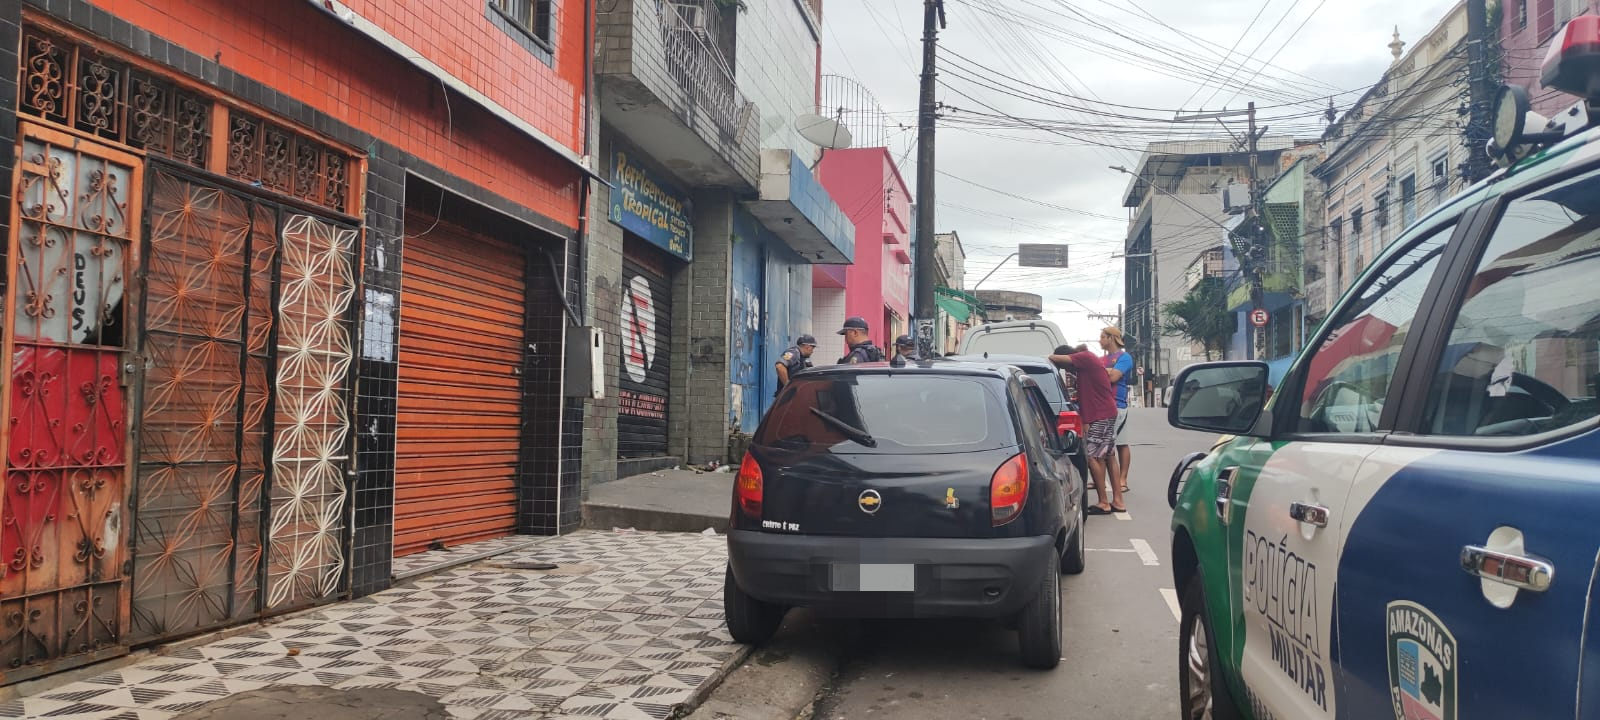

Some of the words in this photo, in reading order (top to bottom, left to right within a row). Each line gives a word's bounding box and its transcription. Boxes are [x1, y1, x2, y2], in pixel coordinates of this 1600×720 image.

[72, 253, 86, 330] DEUS
[1245, 530, 1321, 659] POLÍCIA
[1269, 623, 1328, 713] MILITAR
[1389, 608, 1452, 671] AMAZONAS
